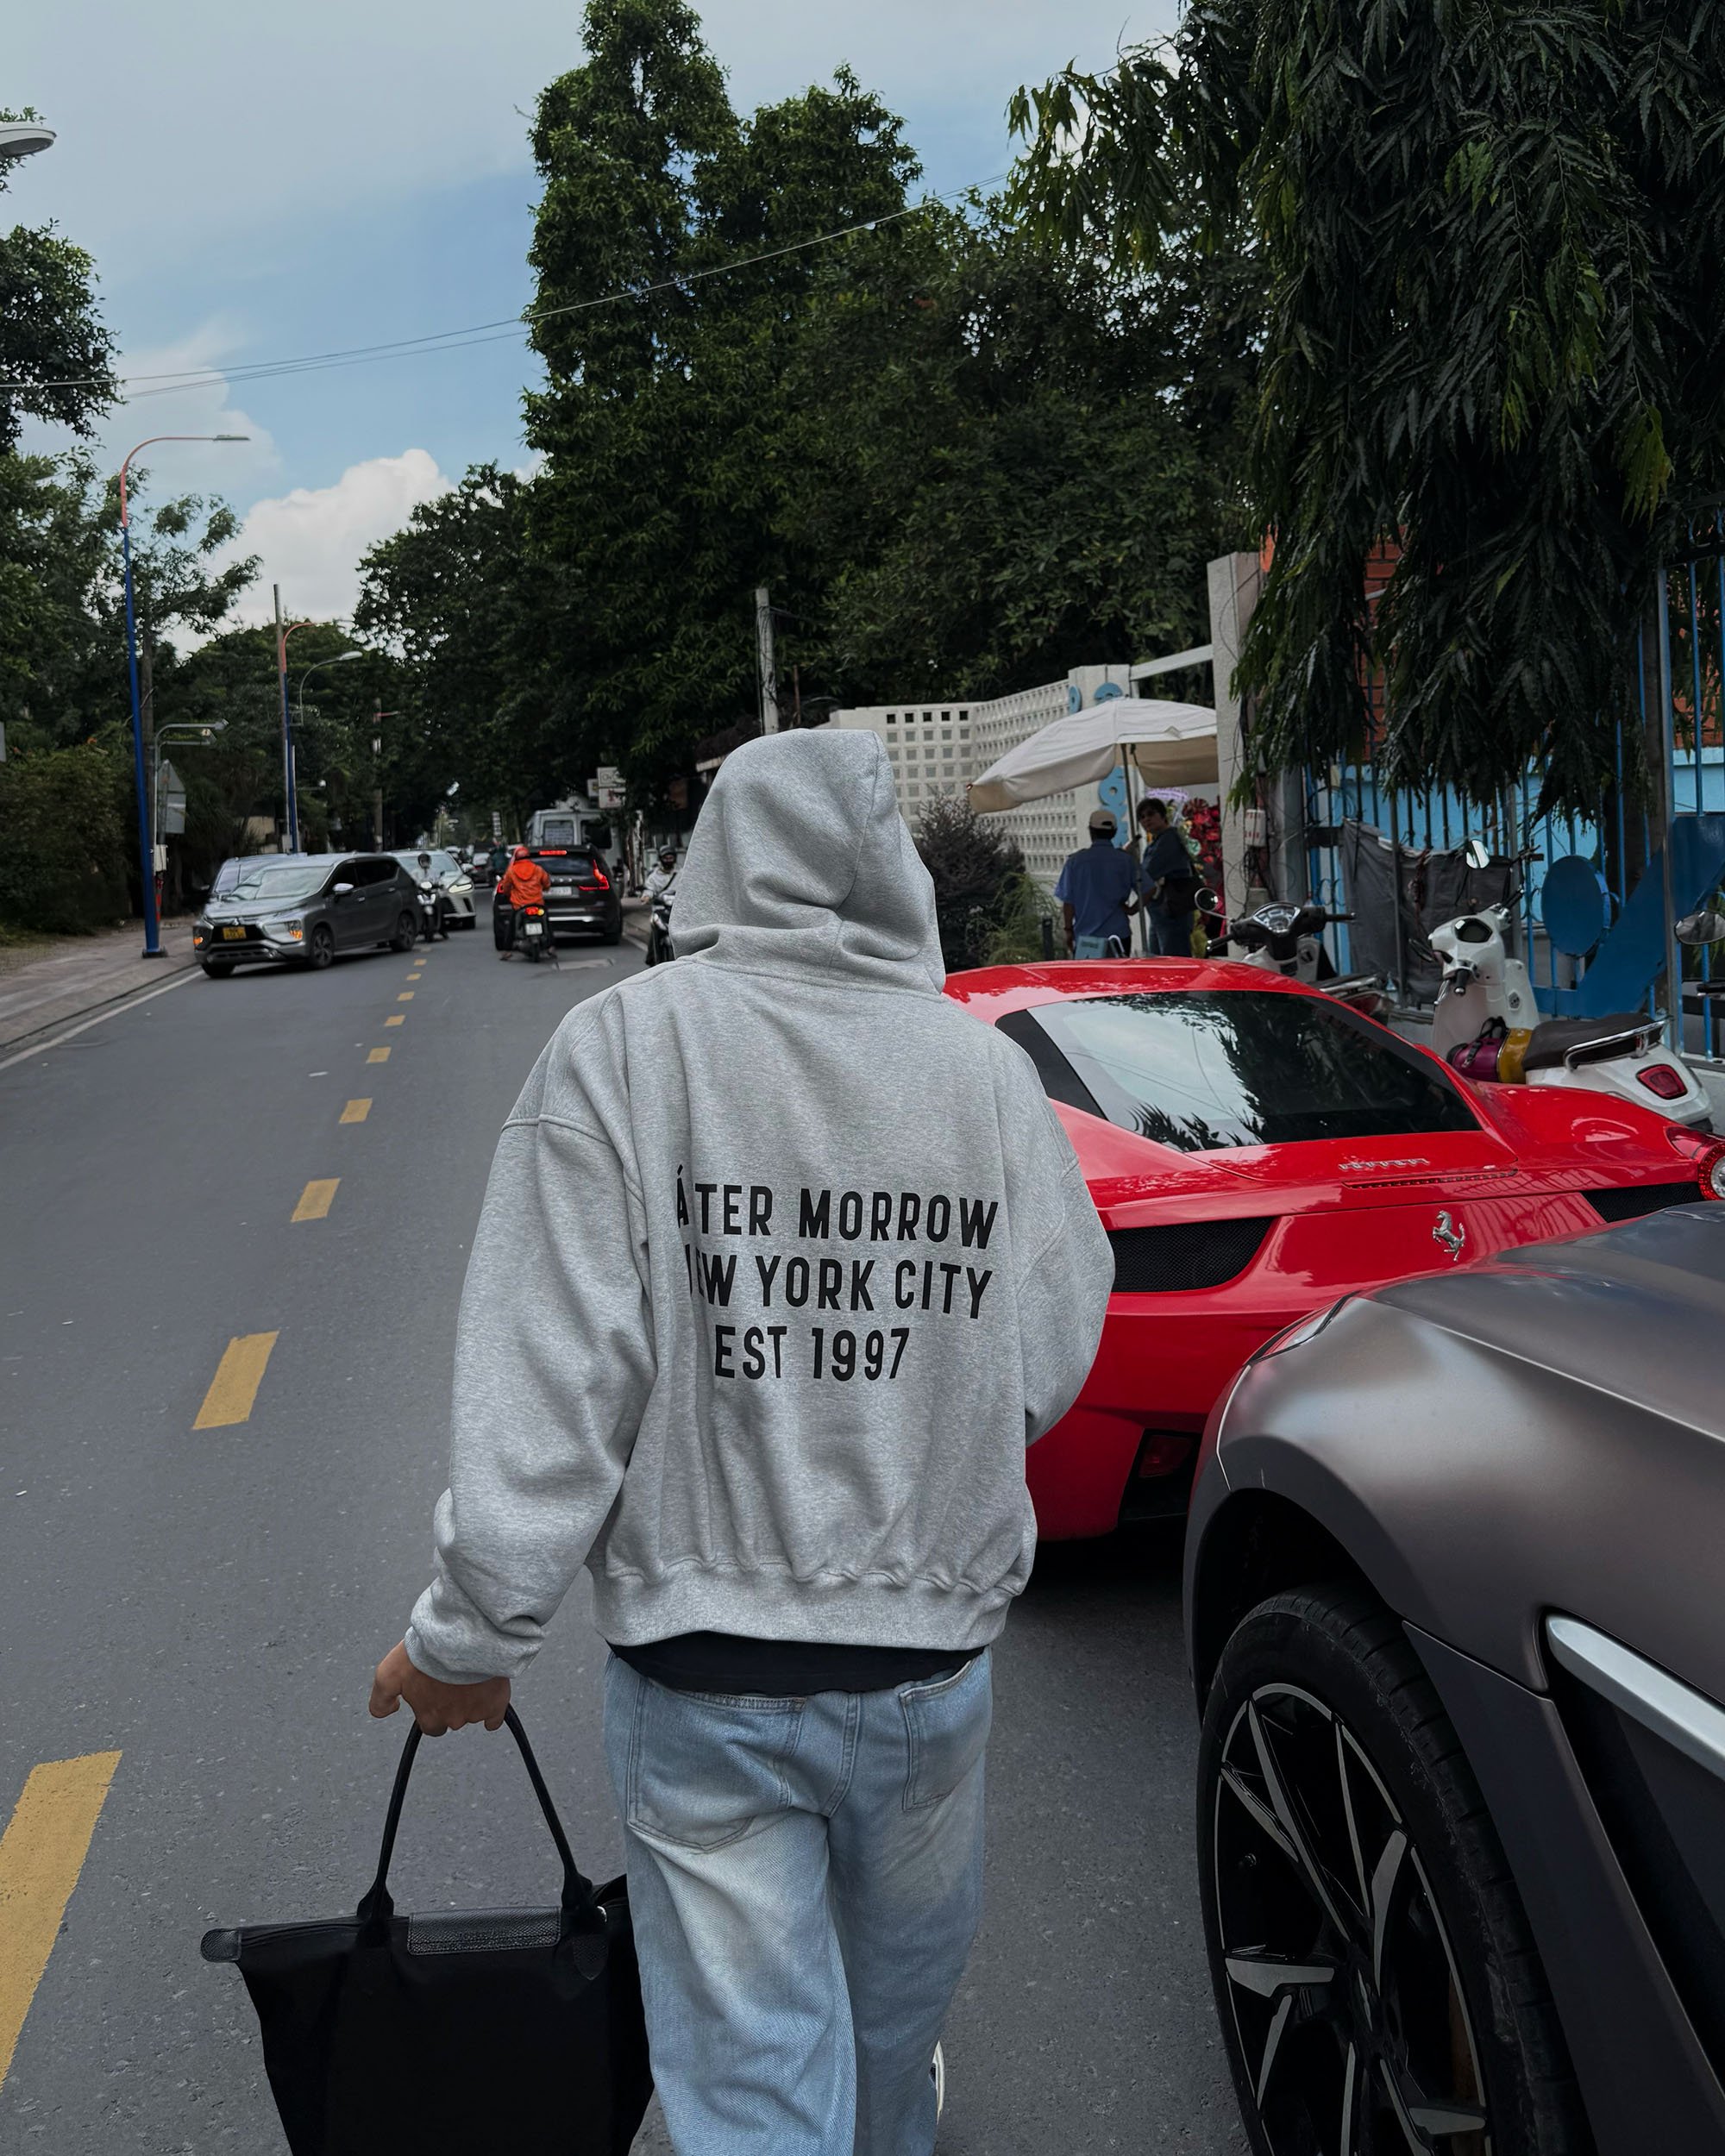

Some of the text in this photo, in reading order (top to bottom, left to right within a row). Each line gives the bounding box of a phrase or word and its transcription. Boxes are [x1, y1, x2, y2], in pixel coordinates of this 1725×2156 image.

[799, 1188, 999, 1250] MORROW
[755, 1255, 875, 1311] YORK
[894, 1259, 993, 1319] CITY
[714, 1324, 910, 1382] EST 1997
